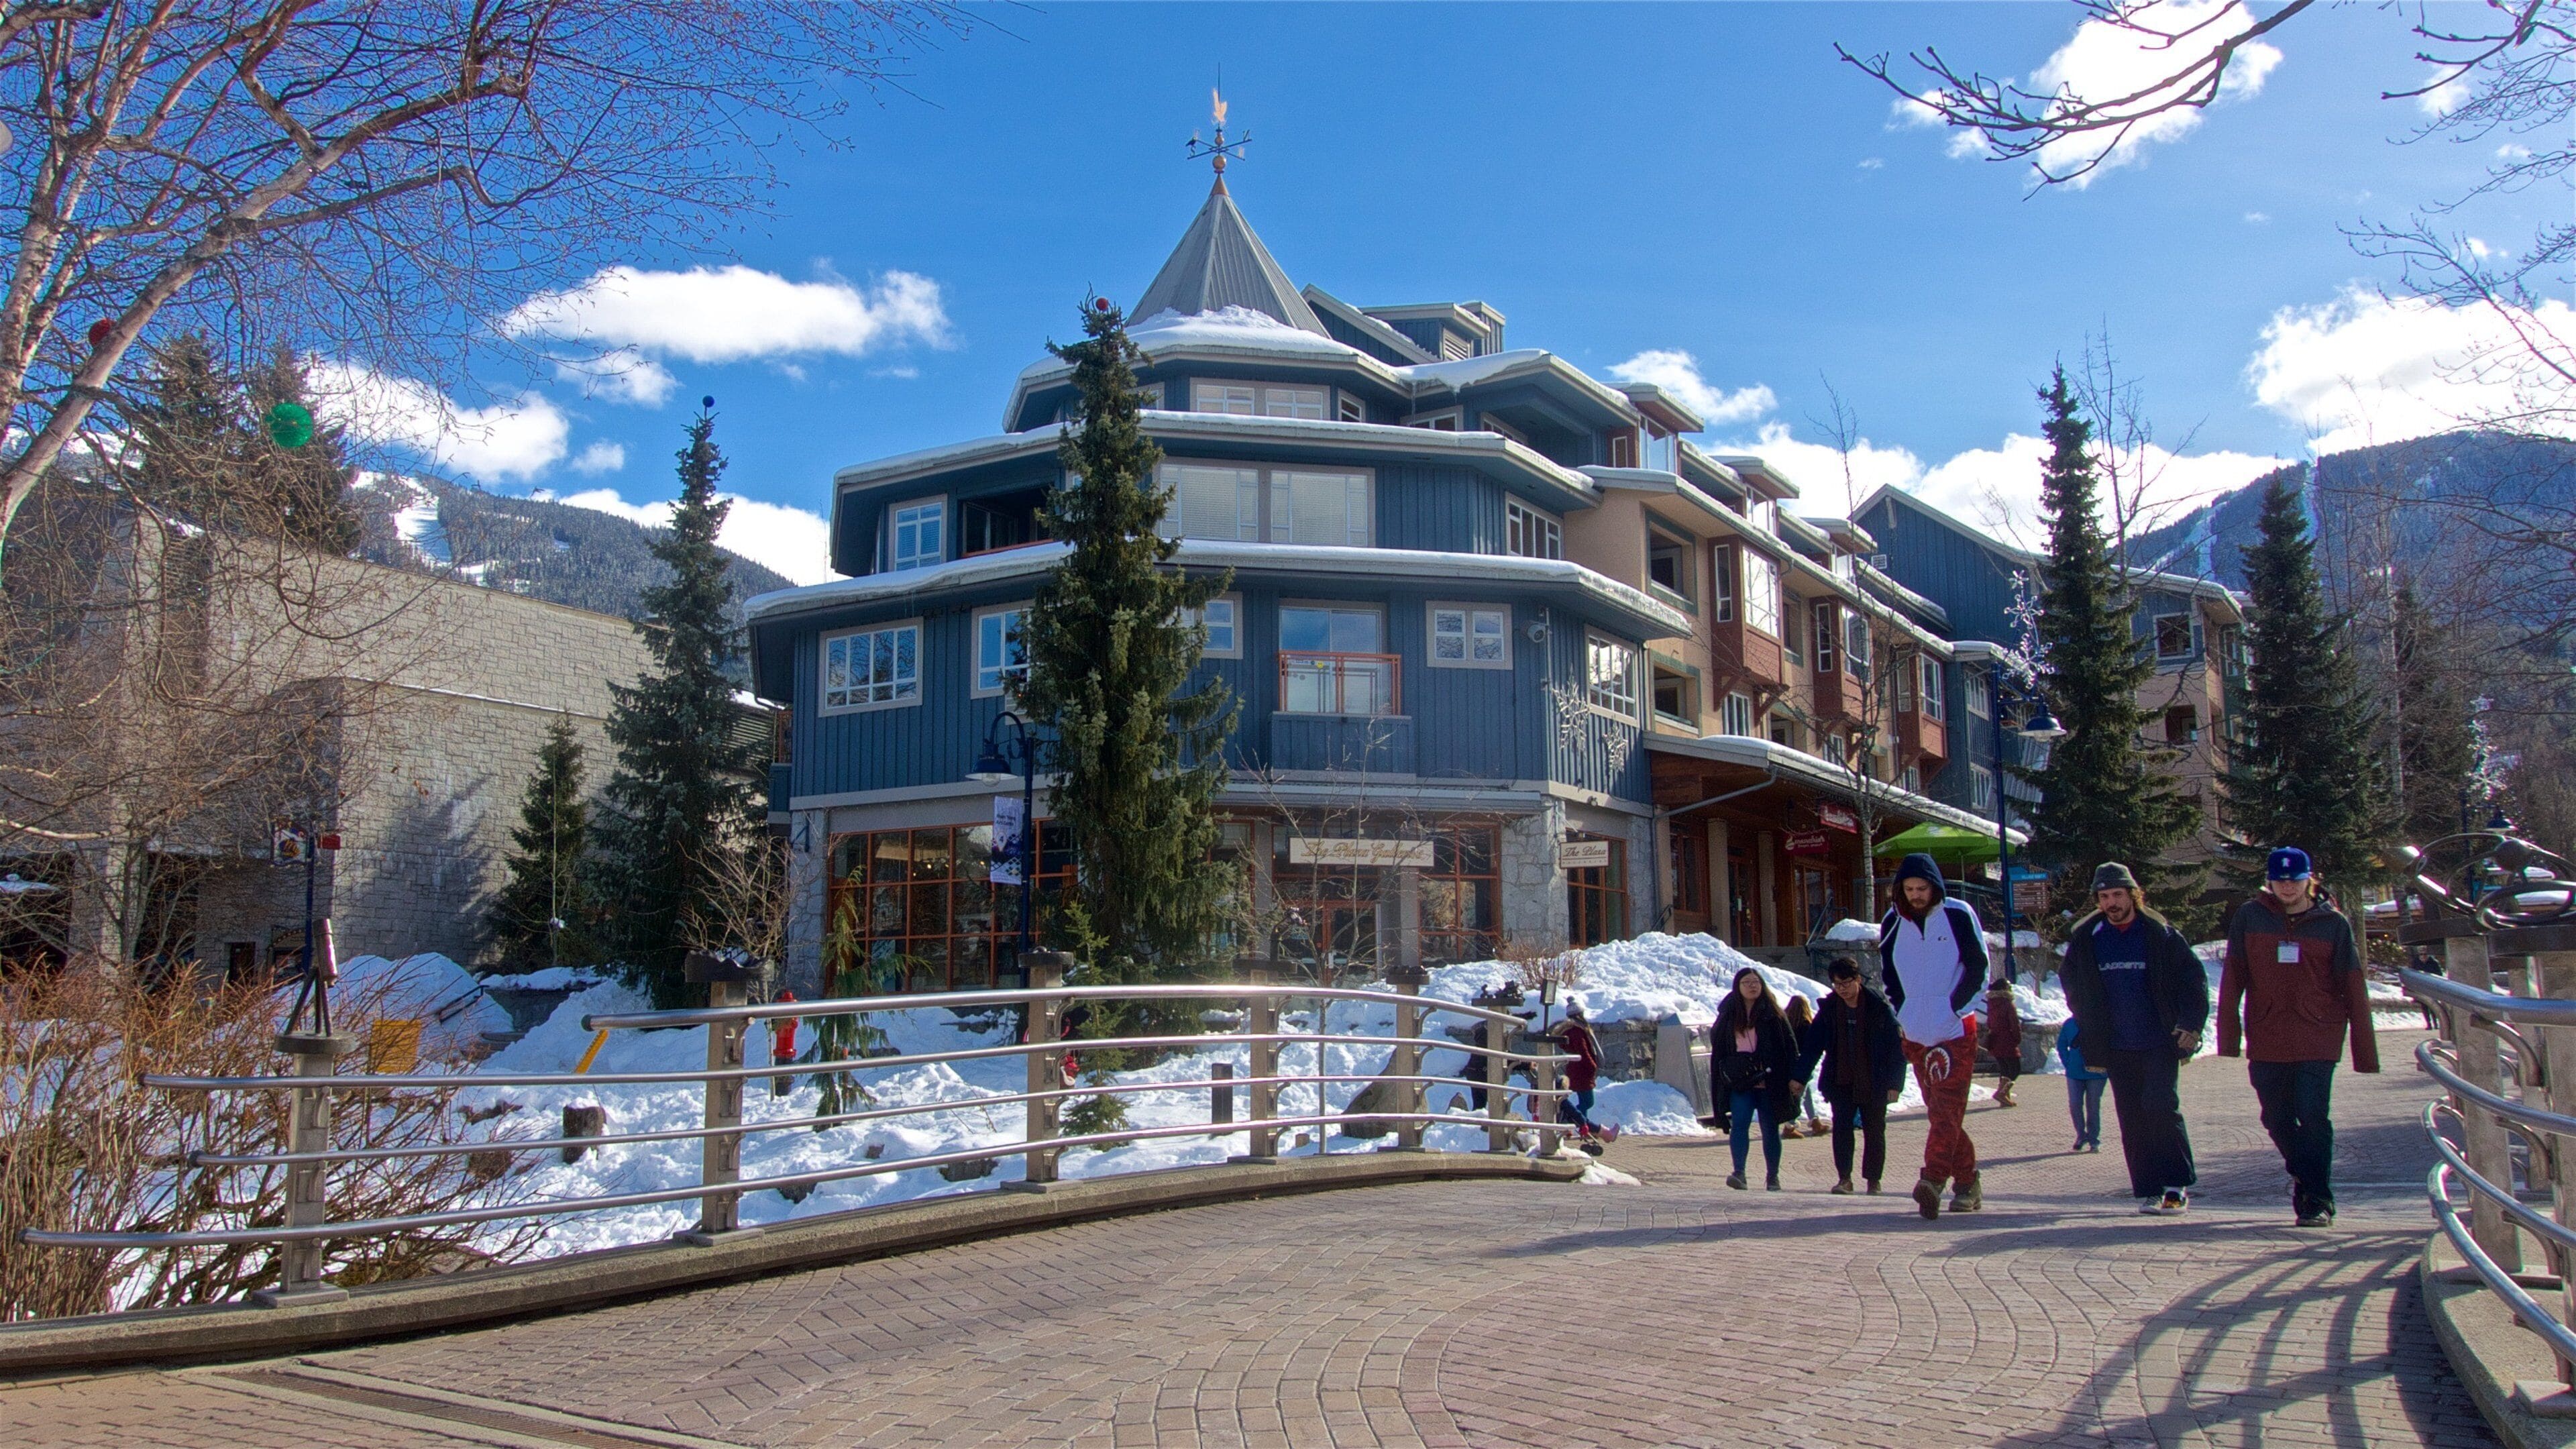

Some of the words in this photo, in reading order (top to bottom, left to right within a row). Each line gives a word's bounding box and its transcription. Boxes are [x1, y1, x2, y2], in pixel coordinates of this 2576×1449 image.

[1300, 840, 1329, 857] The
[1332, 840, 1369, 858] Plaza
[1562, 845, 1580, 857] The
[1582, 845, 1606, 856] Plaza
[2098, 961, 2146, 971] LACOSTE
